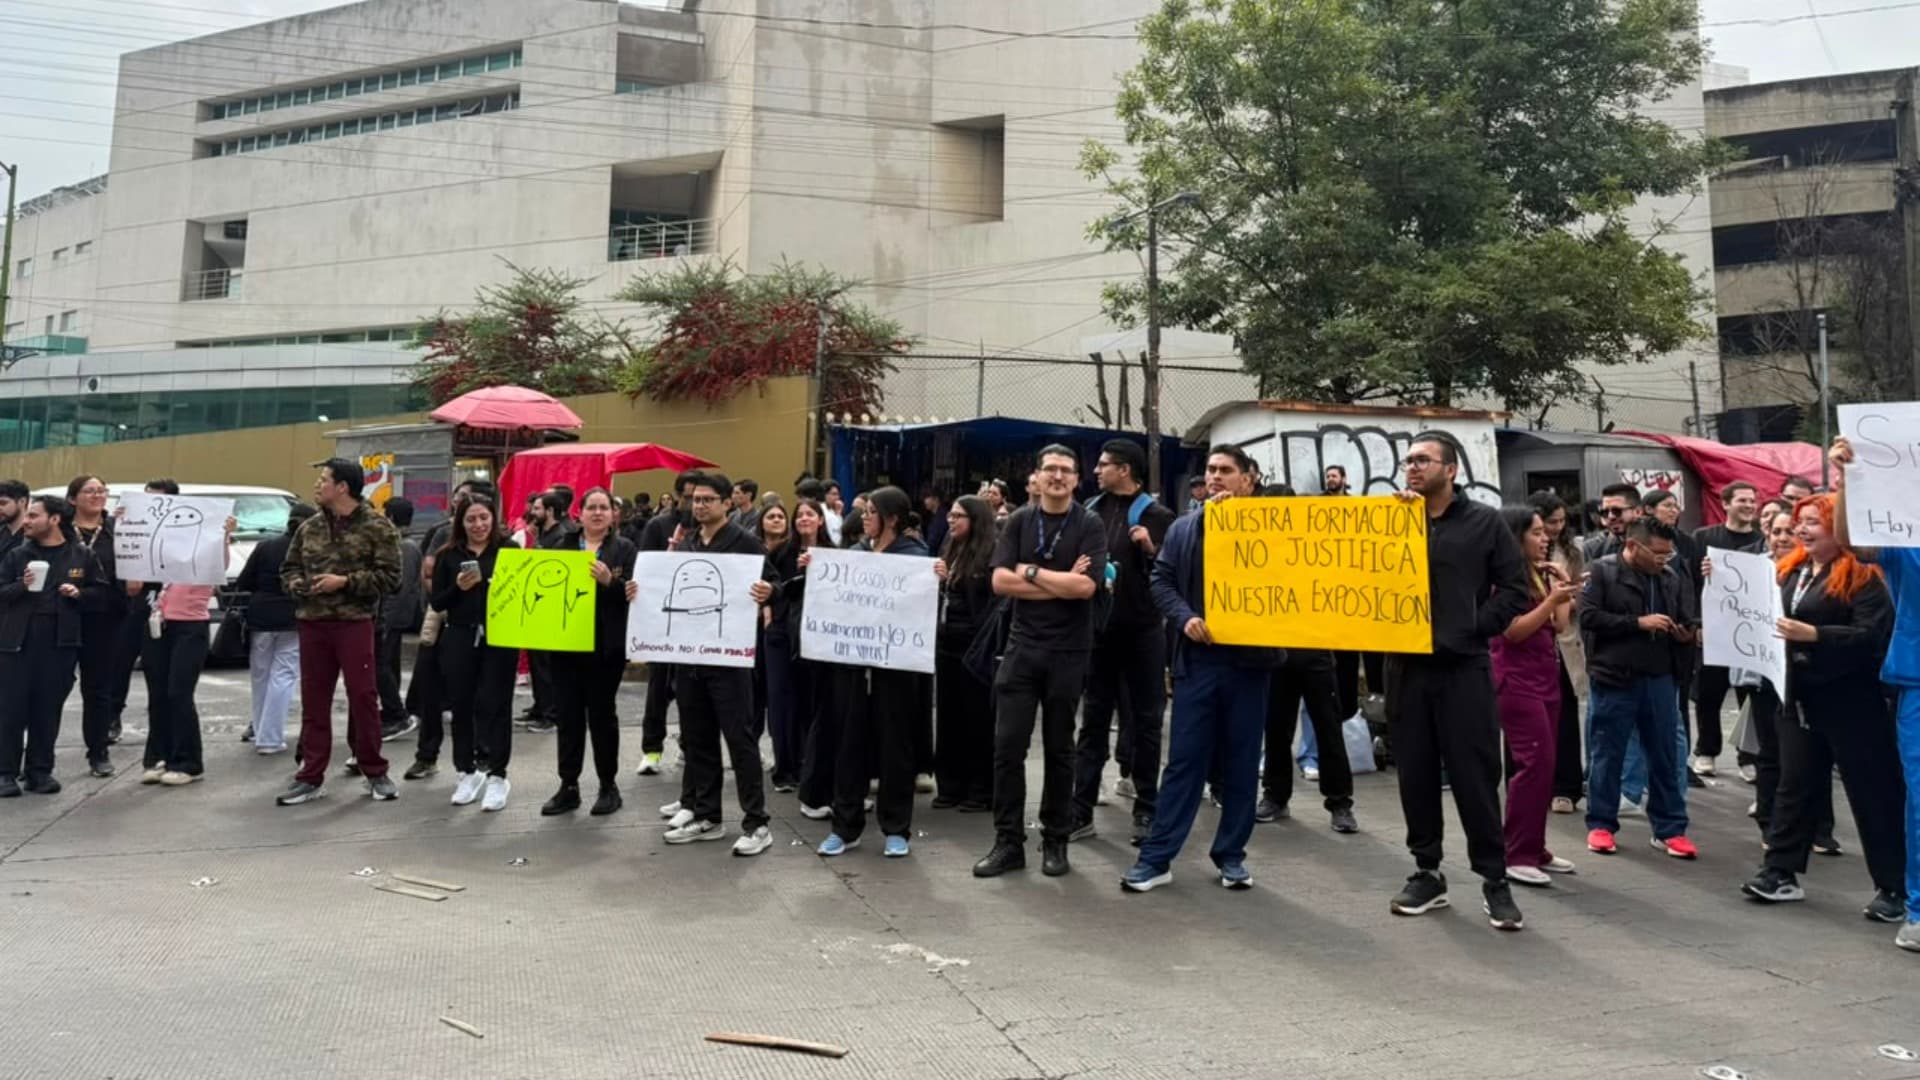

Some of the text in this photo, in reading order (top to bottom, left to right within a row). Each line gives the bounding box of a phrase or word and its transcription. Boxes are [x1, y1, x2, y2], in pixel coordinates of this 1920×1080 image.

[1857, 414, 1920, 468] Si
[1209, 505, 1293, 533] NUESTRA
[1867, 508, 1913, 539] Hay
[1234, 537, 1417, 575] NO JUSTIFICA
[1210, 579, 1431, 625] NUESTRA EXPOSICIÓN
[1720, 594, 1777, 627] Resid
